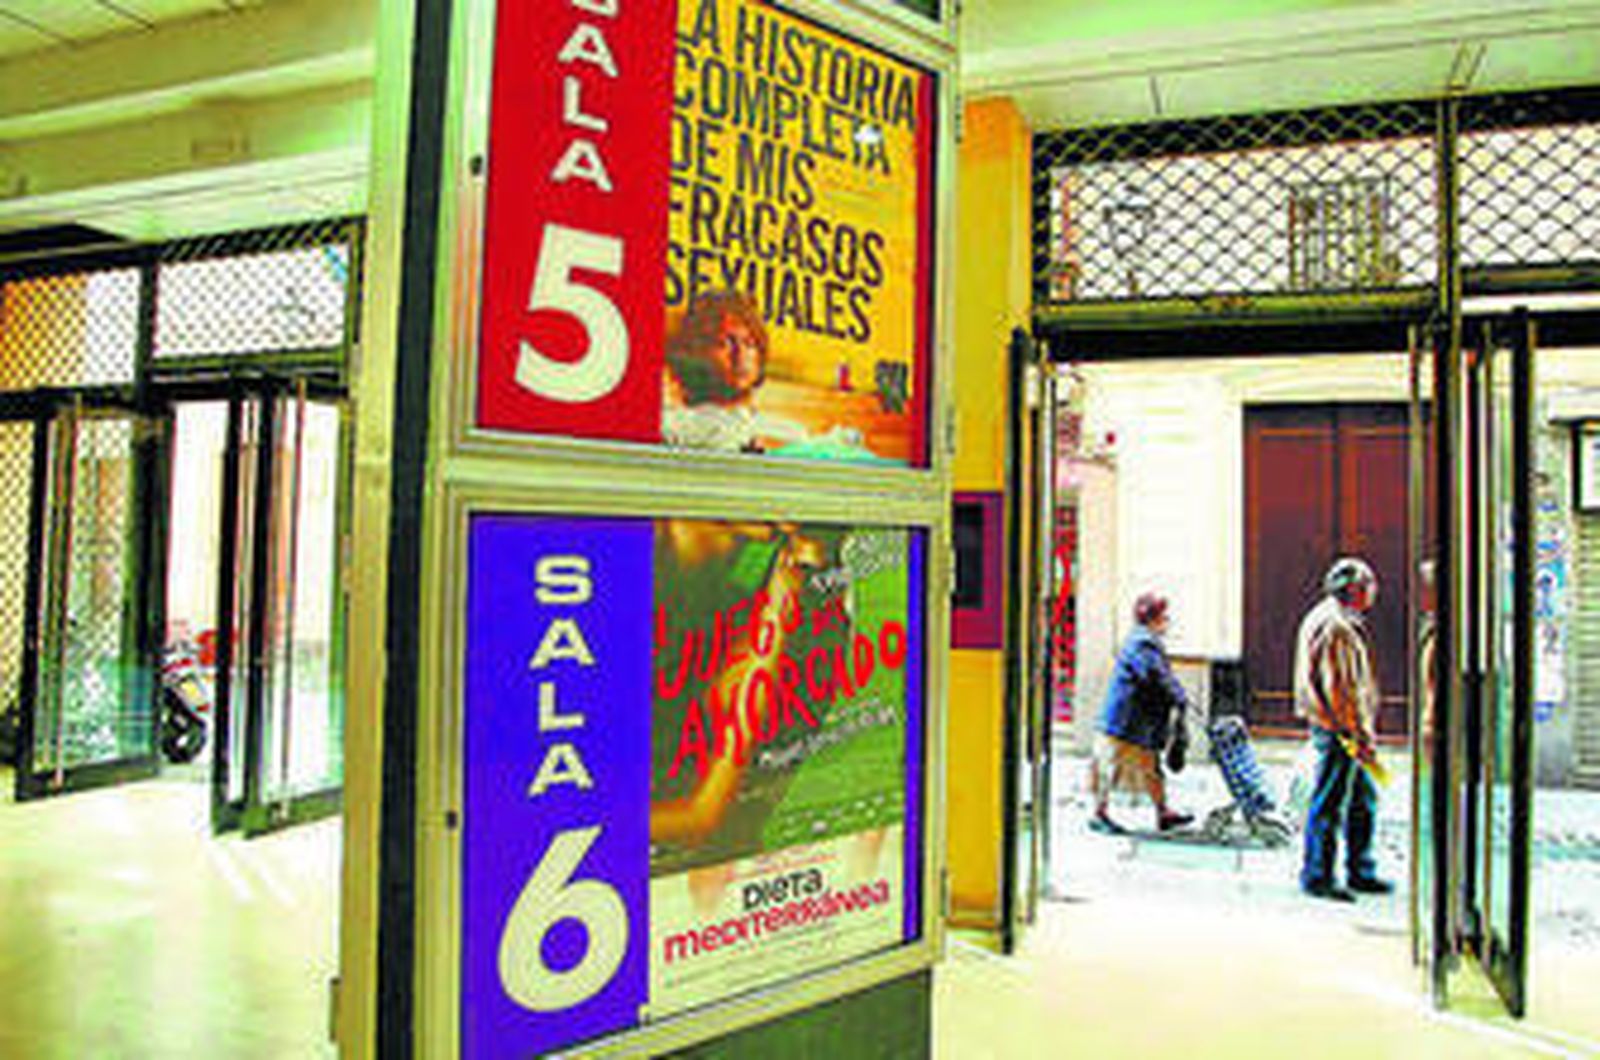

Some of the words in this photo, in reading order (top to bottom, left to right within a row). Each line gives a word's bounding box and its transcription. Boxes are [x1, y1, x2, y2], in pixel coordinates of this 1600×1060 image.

[735, 5, 916, 131] HISTORIA
[672, 113, 722, 183] DE
[736, 132, 814, 211] MIS
[514, 222, 630, 403] 5
[528, 555, 597, 798] SALA
[657, 589, 802, 700] JUEGO
[666, 619, 907, 781] AHORCADO
[498, 825, 630, 1012] 6
